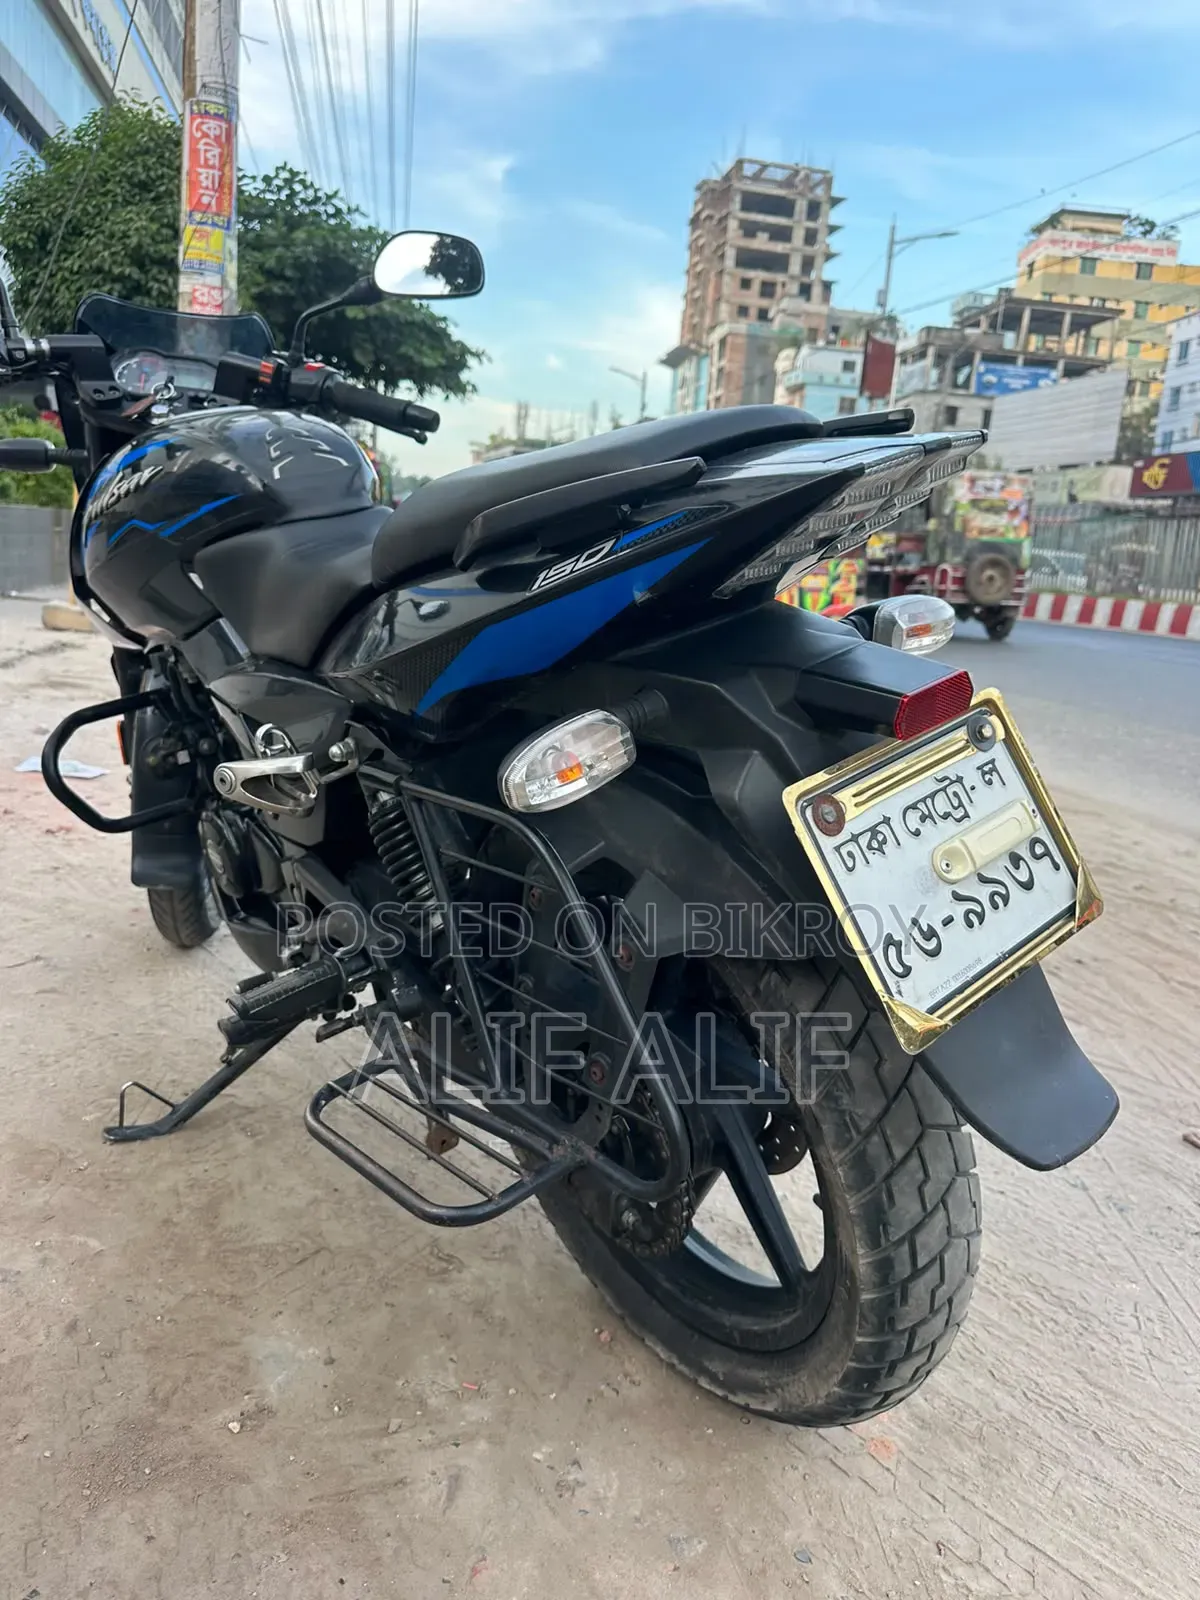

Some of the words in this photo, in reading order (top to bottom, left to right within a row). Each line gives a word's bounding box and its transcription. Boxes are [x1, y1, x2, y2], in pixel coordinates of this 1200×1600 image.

[530, 537, 618, 592] 150
[833, 814, 902, 873] ঢাকা
[883, 836, 1061, 979] ৫৬-৯৯৩৭
